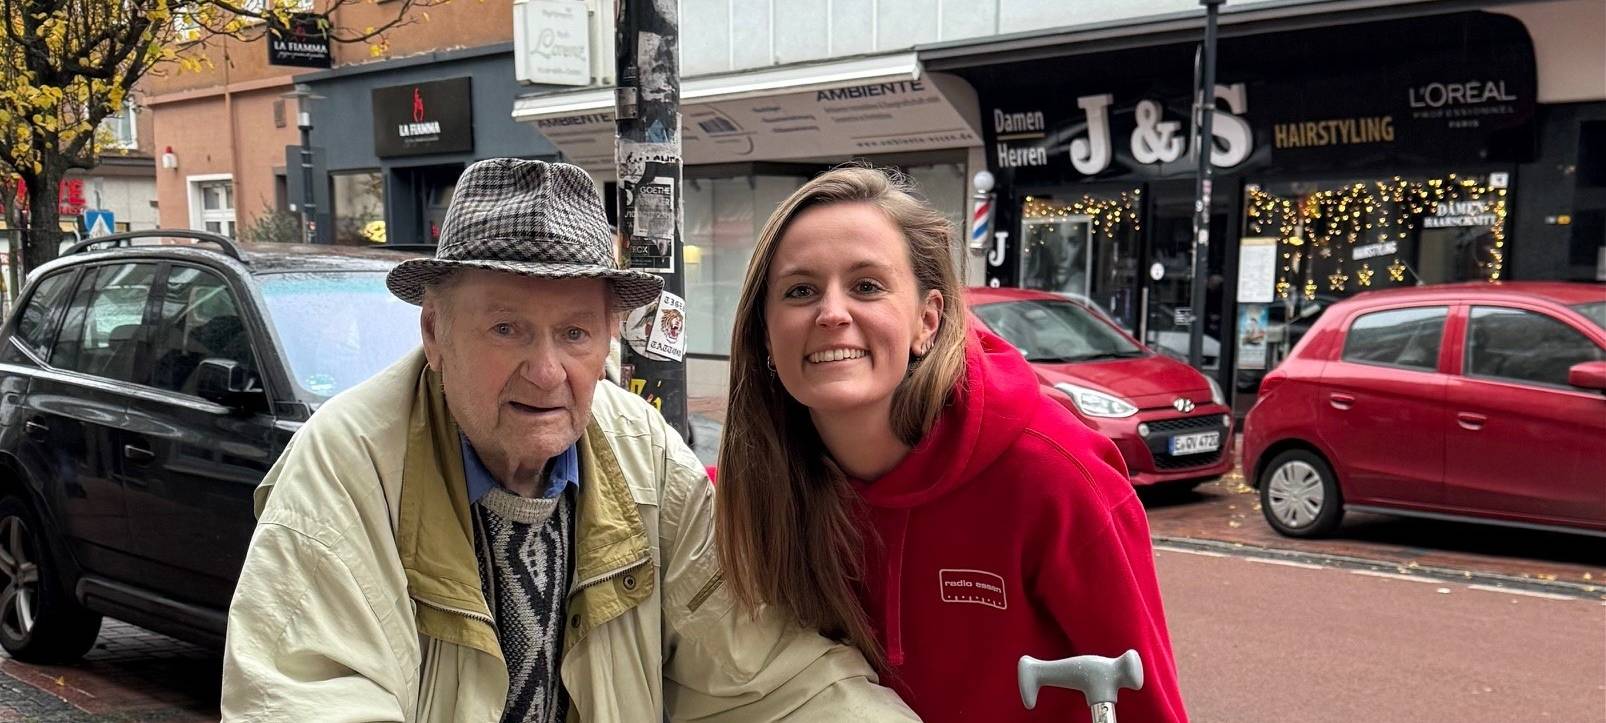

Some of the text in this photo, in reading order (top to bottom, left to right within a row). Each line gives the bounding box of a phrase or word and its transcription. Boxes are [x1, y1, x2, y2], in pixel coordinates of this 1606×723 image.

[273, 41, 328, 54] LA FIAMMA
[816, 80, 925, 102] AMBIENTE
[399, 124, 409, 136] LA
[994, 108, 1044, 133] Damen
[1070, 83, 1253, 175] J & S
[1274, 115, 1394, 149] HAIRSTYLING
[997, 143, 1047, 168] Herren
[650, 340, 682, 357] TATTOO
[944, 579, 1001, 593] radio essen
